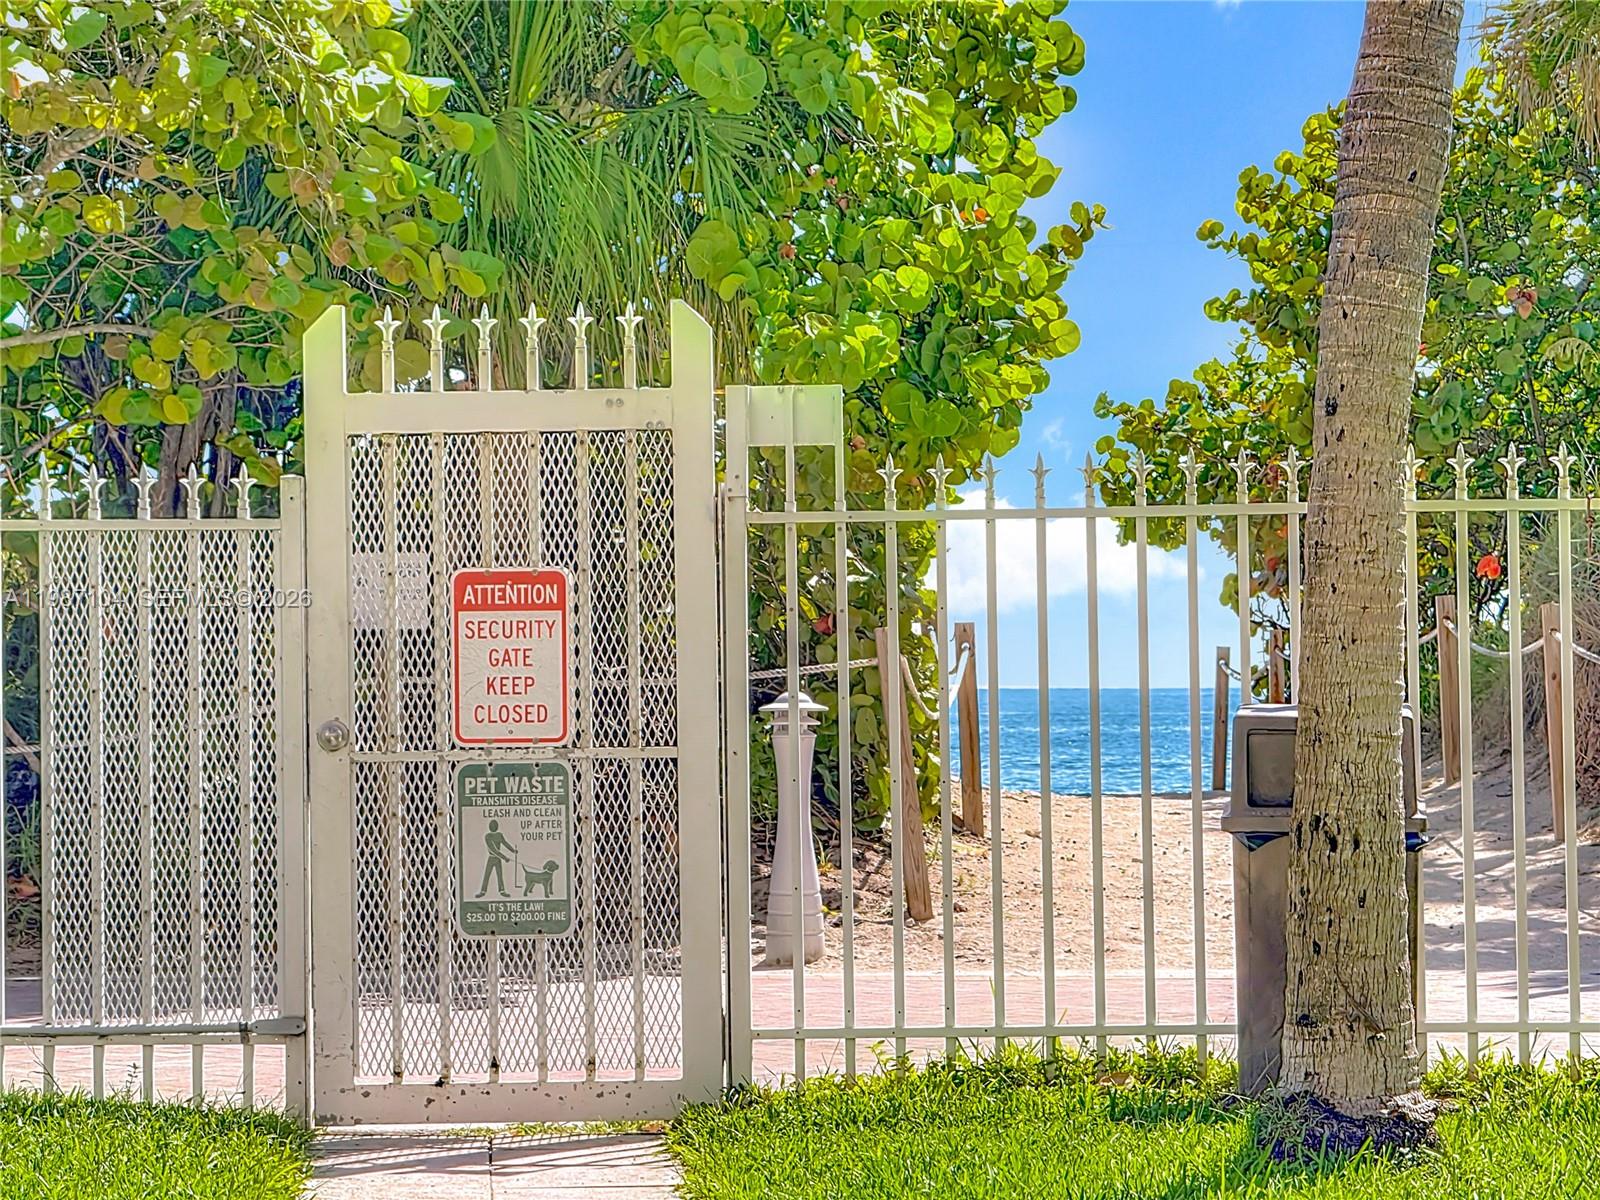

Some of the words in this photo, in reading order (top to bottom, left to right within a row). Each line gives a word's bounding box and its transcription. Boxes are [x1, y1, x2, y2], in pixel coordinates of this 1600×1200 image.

[463, 583, 558, 605] ATTENTION
[464, 620, 556, 639] SECURITY
[488, 648, 533, 668] GATE
[486, 676, 535, 696] KEEP
[474, 704, 549, 724] CLOSED
[464, 776, 498, 794] PET
[504, 776, 565, 793] WASTE
[471, 796, 520, 805] TRANSMITS
[522, 796, 558, 805] DISEASE
[482, 808, 511, 818] LEASH
[514, 808, 531, 818] AND
[534, 808, 562, 817] CLEAN
[520, 820, 533, 829] UP
[535, 819, 562, 829] AFTER
[520, 831, 544, 841] YOUR
[546, 831, 562, 841] PET
[488, 902, 504, 911] IT'S
[506, 902, 522, 911] THE
[523, 902, 544, 911] LAW!
[466, 912, 496, 922] $25.00
[497, 912, 509, 922] TO
[511, 912, 545, 922] $200.00
[547, 912, 567, 921] FINE
